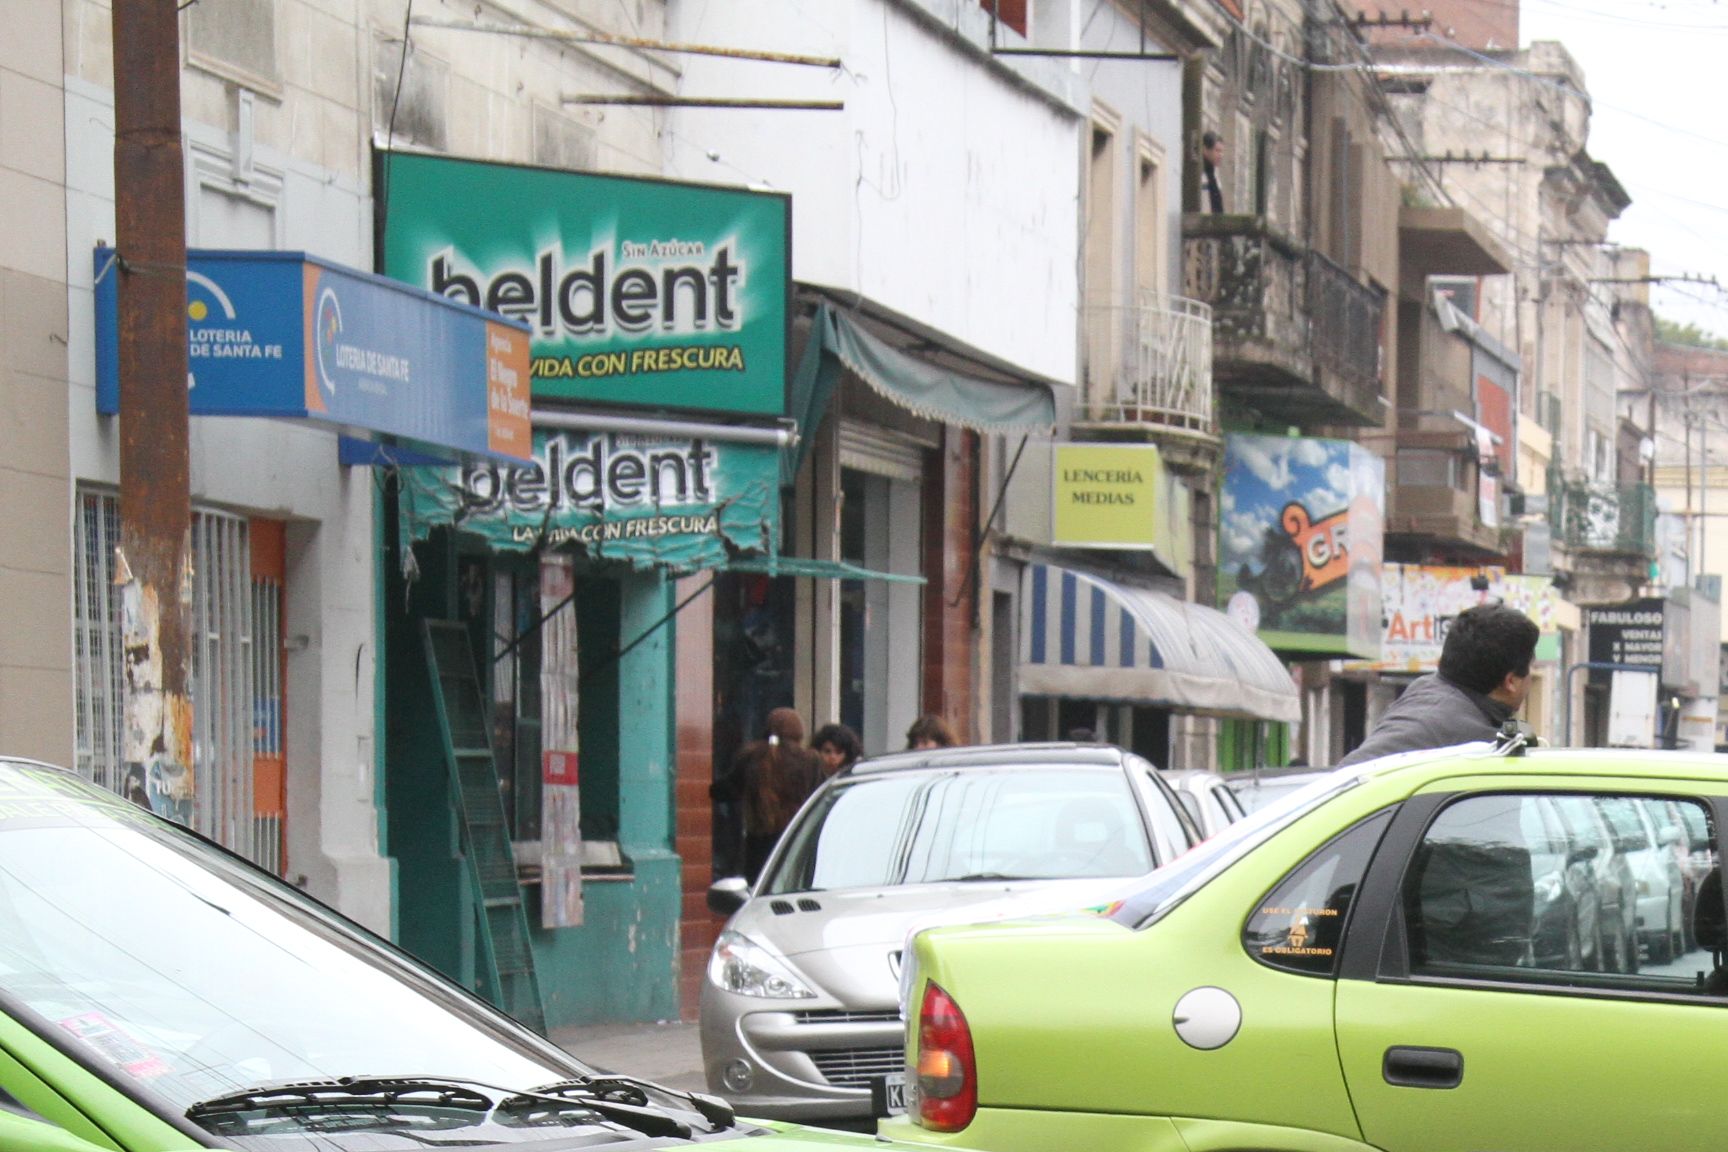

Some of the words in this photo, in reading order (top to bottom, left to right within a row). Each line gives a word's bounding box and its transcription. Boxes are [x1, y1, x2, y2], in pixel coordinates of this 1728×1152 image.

[623, 242, 646, 257] SIN
[432, 246, 738, 332] beldent
[189, 328, 252, 342] LOTERIA
[190, 343, 210, 357] DE
[213, 344, 262, 358] SANTA
[264, 345, 282, 358] FE
[577, 352, 626, 376] CON
[631, 347, 744, 372] FRESCURA
[461, 438, 713, 507] beldent
[1072, 492, 1135, 505] MEDIAS
[513, 526, 534, 542] LA
[581, 521, 621, 540] CON
[626, 516, 719, 538] FRESCURA
[1590, 610, 1663, 625] FABULOSO
